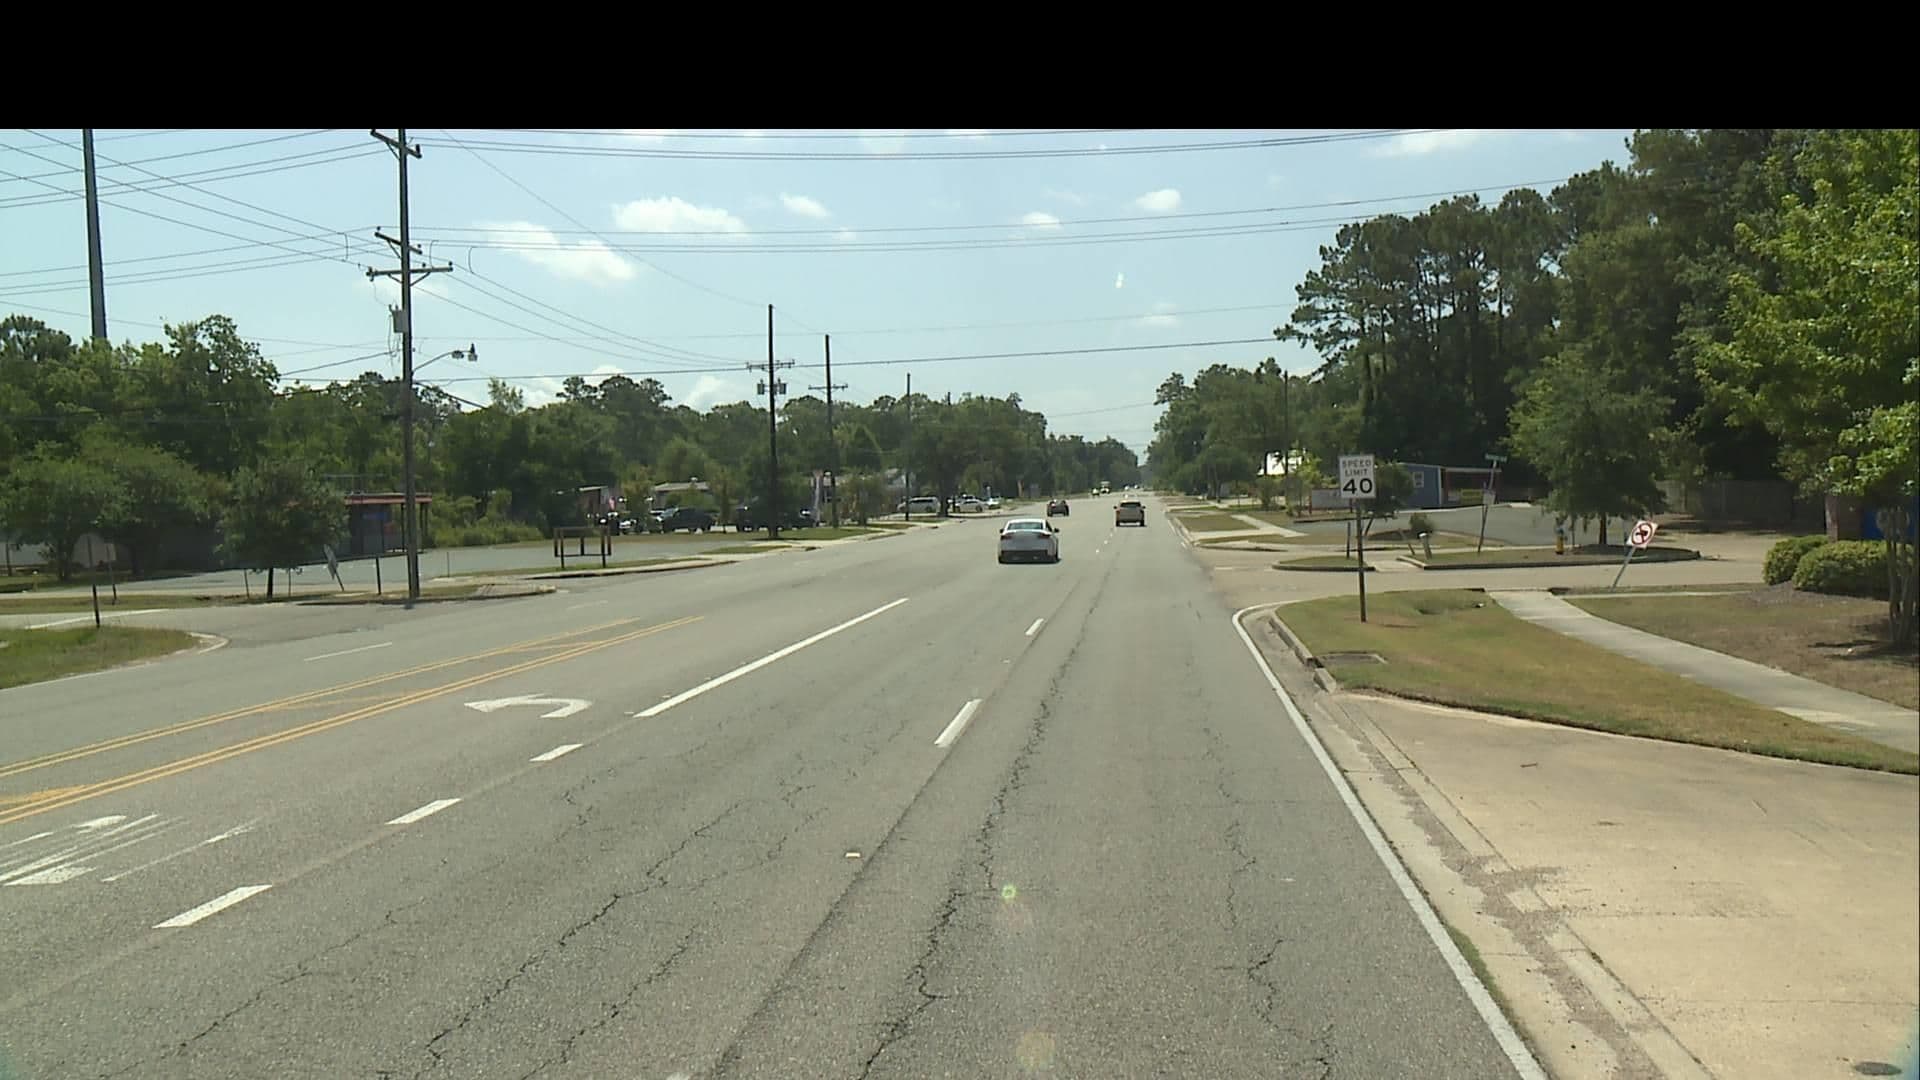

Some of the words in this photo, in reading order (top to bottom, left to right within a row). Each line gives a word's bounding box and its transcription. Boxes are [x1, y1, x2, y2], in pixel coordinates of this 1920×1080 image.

[1342, 459, 1371, 468] SPEED
[1345, 469, 1368, 477] LIMIT
[1342, 478, 1373, 494] 40
